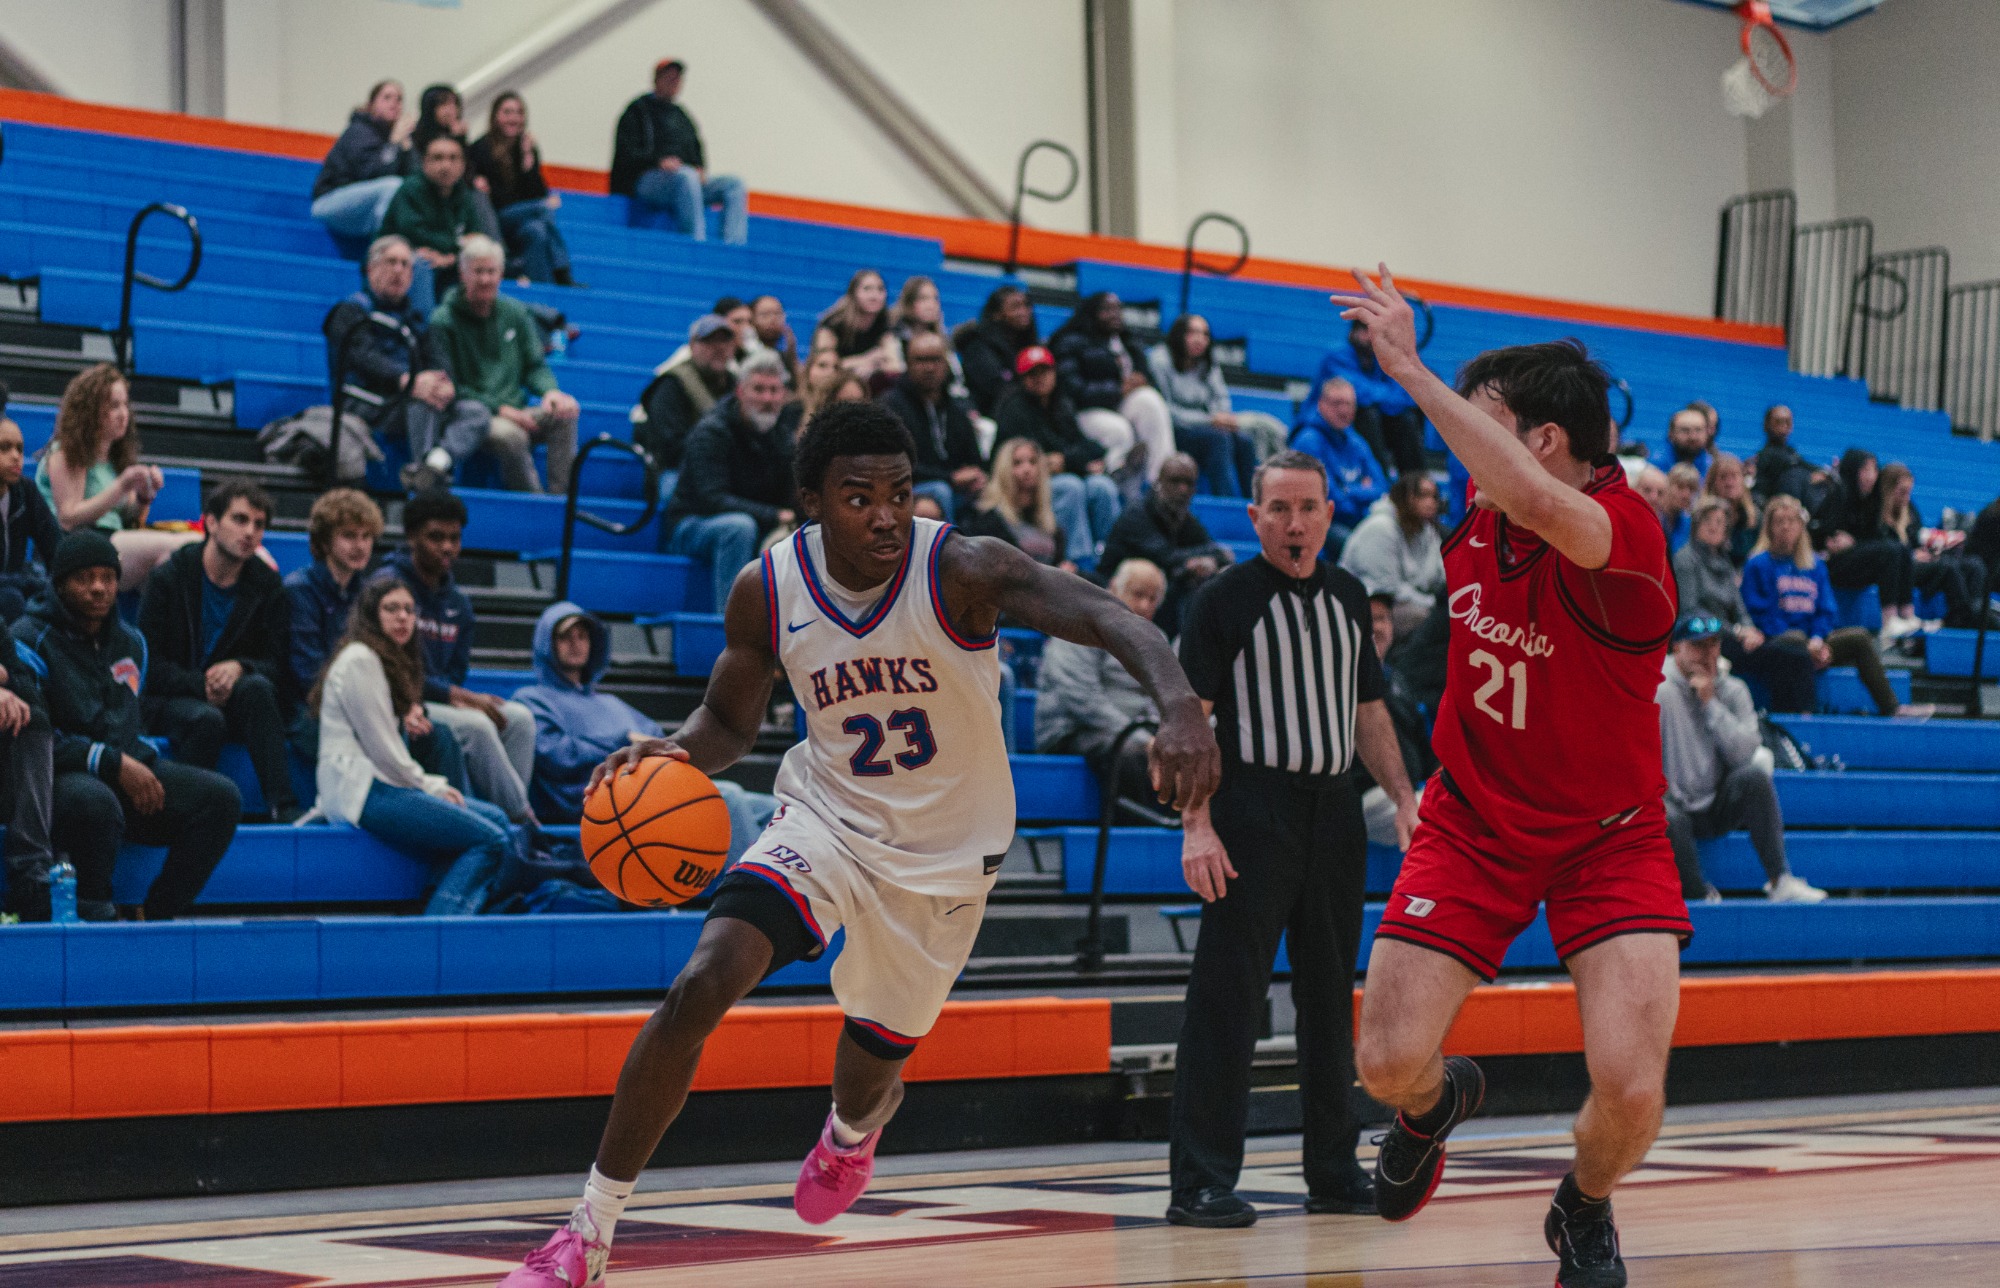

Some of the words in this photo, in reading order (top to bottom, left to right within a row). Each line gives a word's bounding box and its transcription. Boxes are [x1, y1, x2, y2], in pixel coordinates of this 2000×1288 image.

[1449, 582, 1555, 658] Oneonta
[809, 656, 939, 712] HAWKS
[1469, 648, 1528, 730] 21
[841, 706, 938, 777] 23
[762, 844, 812, 873] NP
